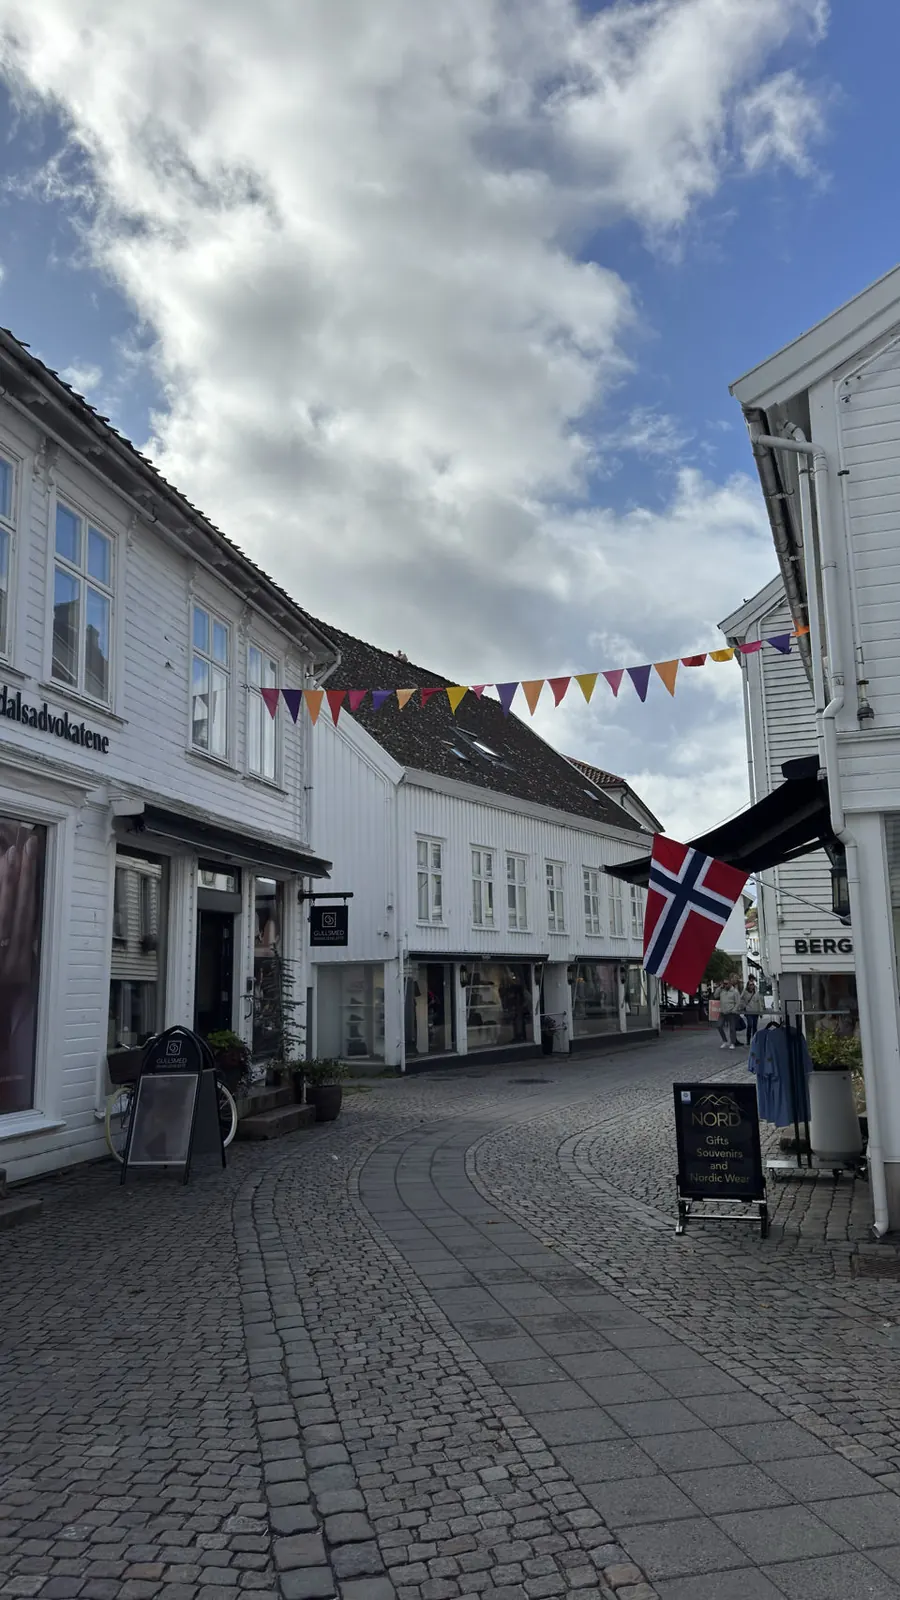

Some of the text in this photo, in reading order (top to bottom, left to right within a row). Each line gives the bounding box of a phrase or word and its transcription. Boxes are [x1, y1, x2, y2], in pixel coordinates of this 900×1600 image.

[794, 939, 853, 954] BERG
[691, 1112, 742, 1127] NORD
[706, 1135, 729, 1146] Gifts
[696, 1148, 743, 1159] Souvenirs
[710, 1161, 728, 1170] and
[690, 1173, 750, 1184] Nordic Wear
